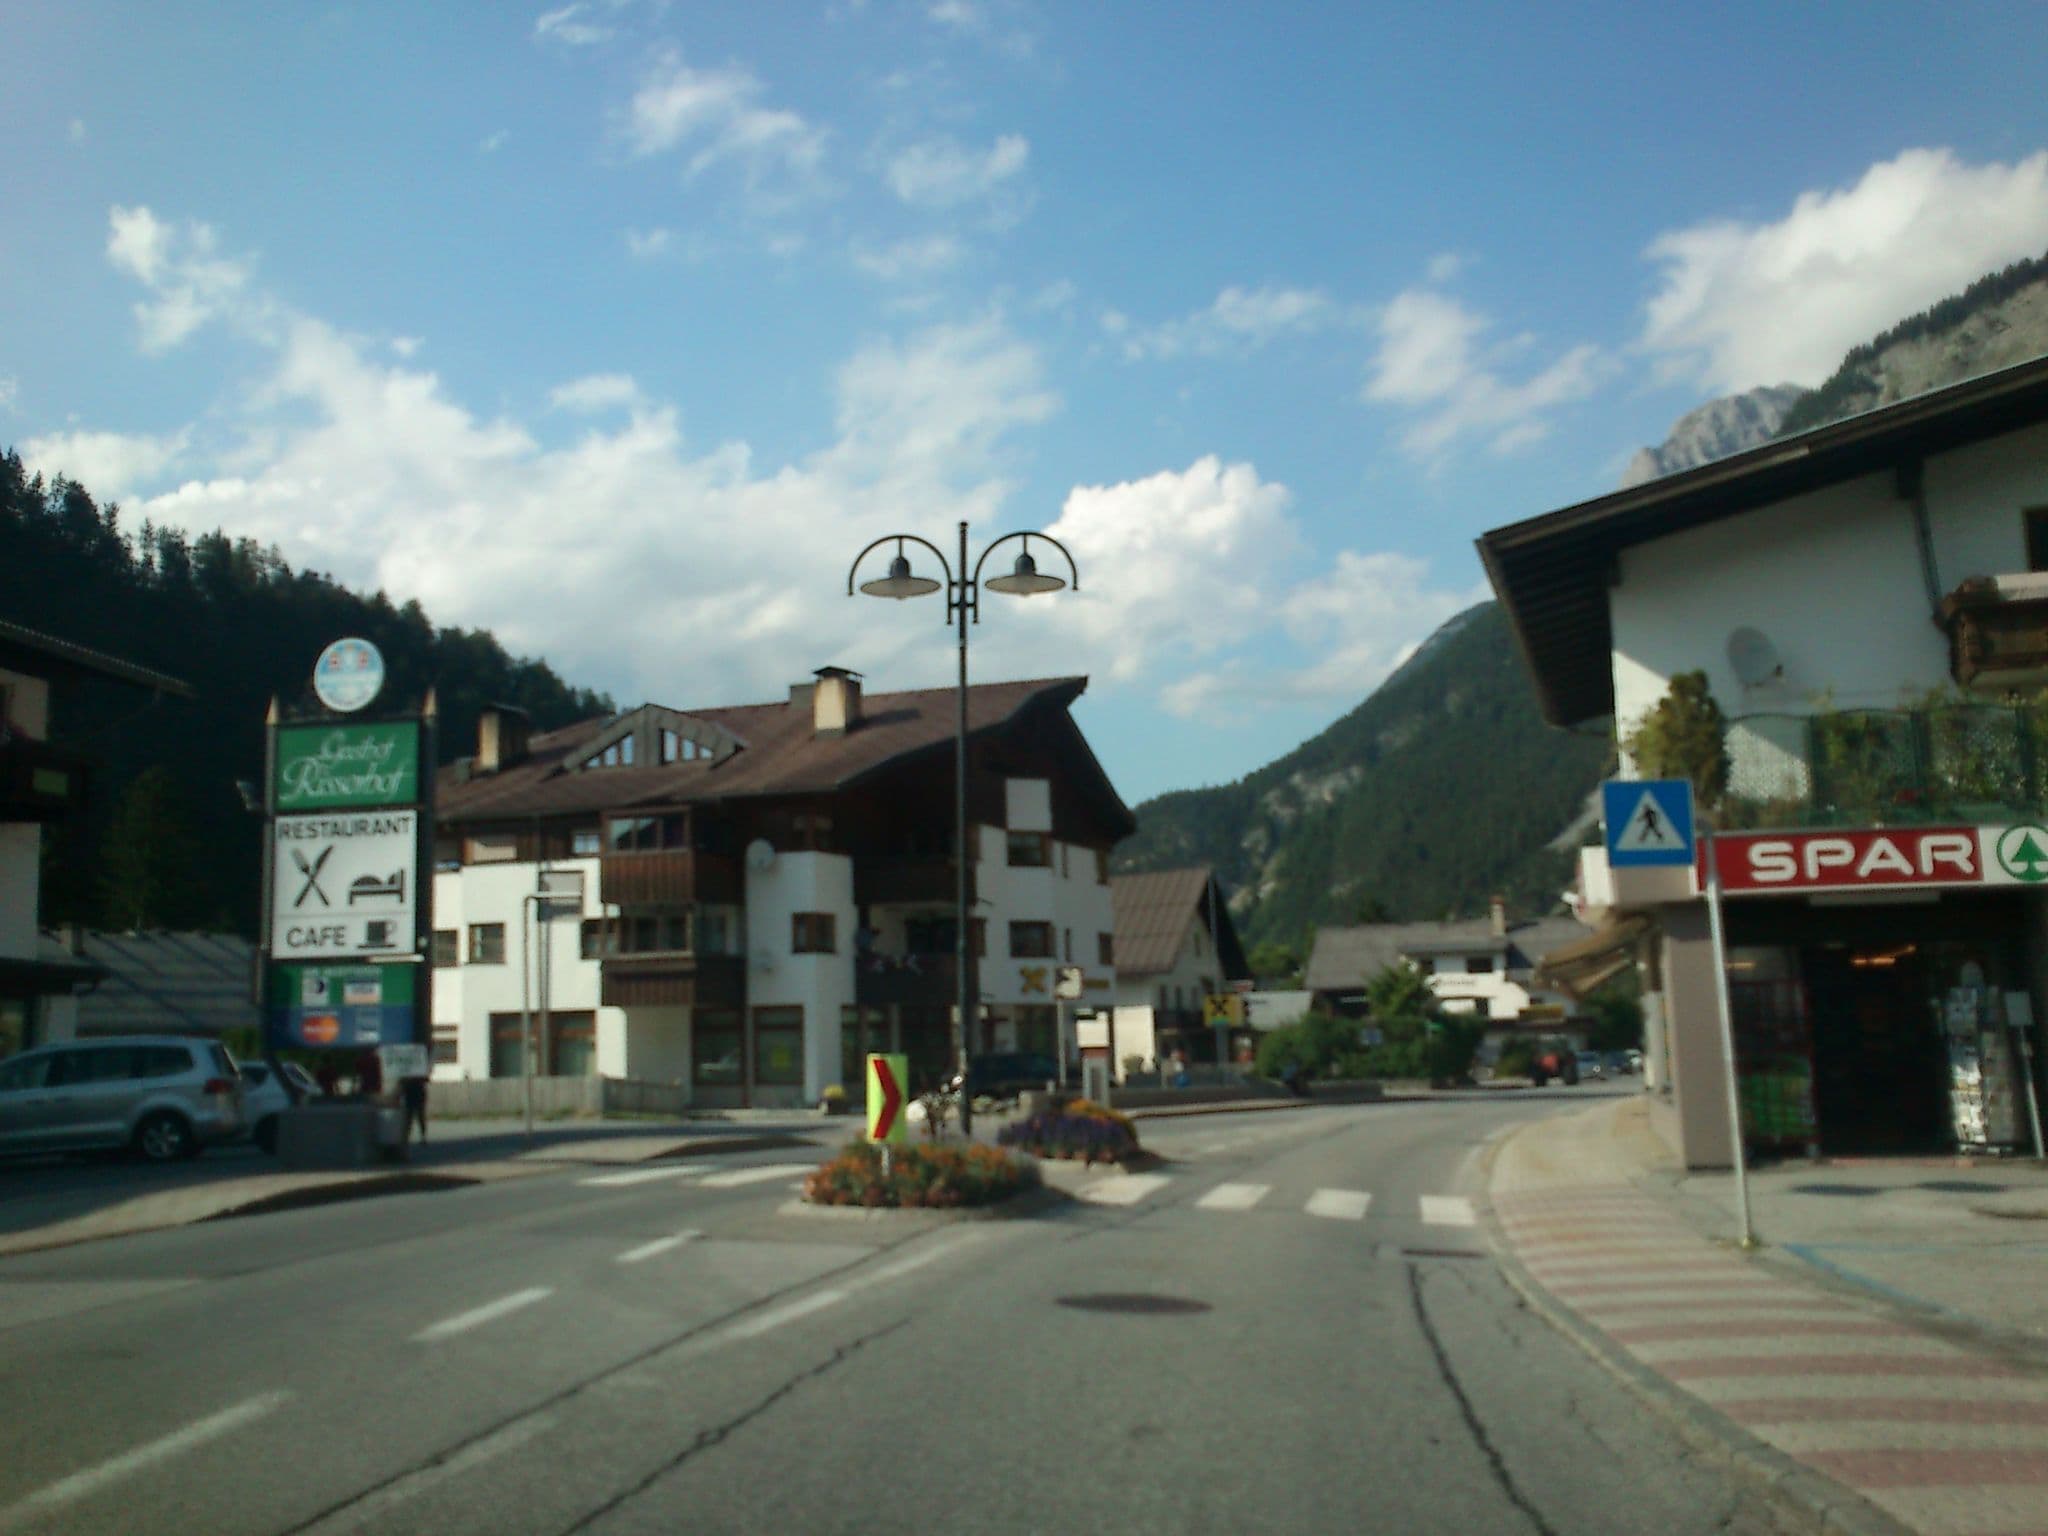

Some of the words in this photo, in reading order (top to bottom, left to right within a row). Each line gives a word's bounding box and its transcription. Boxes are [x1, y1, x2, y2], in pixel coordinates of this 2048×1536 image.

[278, 815, 411, 840] RESTAURANT
[1748, 834, 1975, 882] SPAR
[286, 925, 347, 949] CAFE
